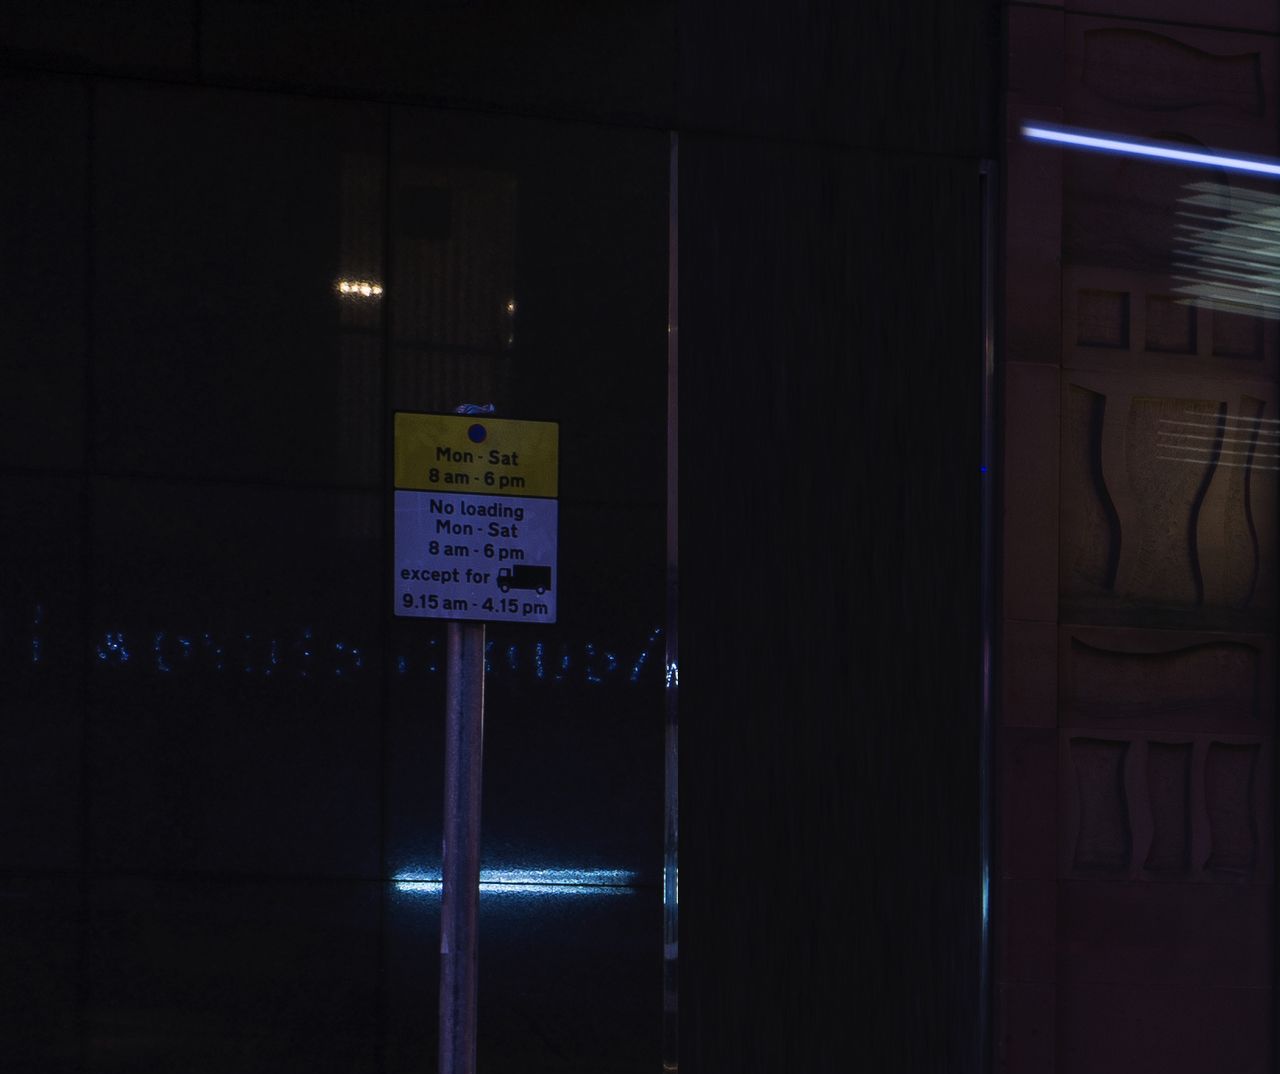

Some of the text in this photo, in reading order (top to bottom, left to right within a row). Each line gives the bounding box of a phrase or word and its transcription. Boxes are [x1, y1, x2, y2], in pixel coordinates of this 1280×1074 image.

[436, 447, 473, 464] Mon
[488, 450, 519, 467] Sat
[429, 468, 440, 483] 8
[444, 471, 470, 485] am
[484, 471, 495, 486] 6
[499, 475, 526, 489] pm
[430, 499, 525, 521] No loading
[436, 519, 473, 536] Mon
[487, 522, 519, 539] Sat
[429, 541, 440, 555] 8
[444, 544, 470, 557] am
[484, 544, 494, 558] 6
[499, 547, 525, 561] pm
[401, 568, 491, 585] except for
[403, 593, 439, 609] 9.15
[443, 598, 469, 611] am
[482, 597, 519, 614] 4.15
[522, 602, 549, 616] pm
